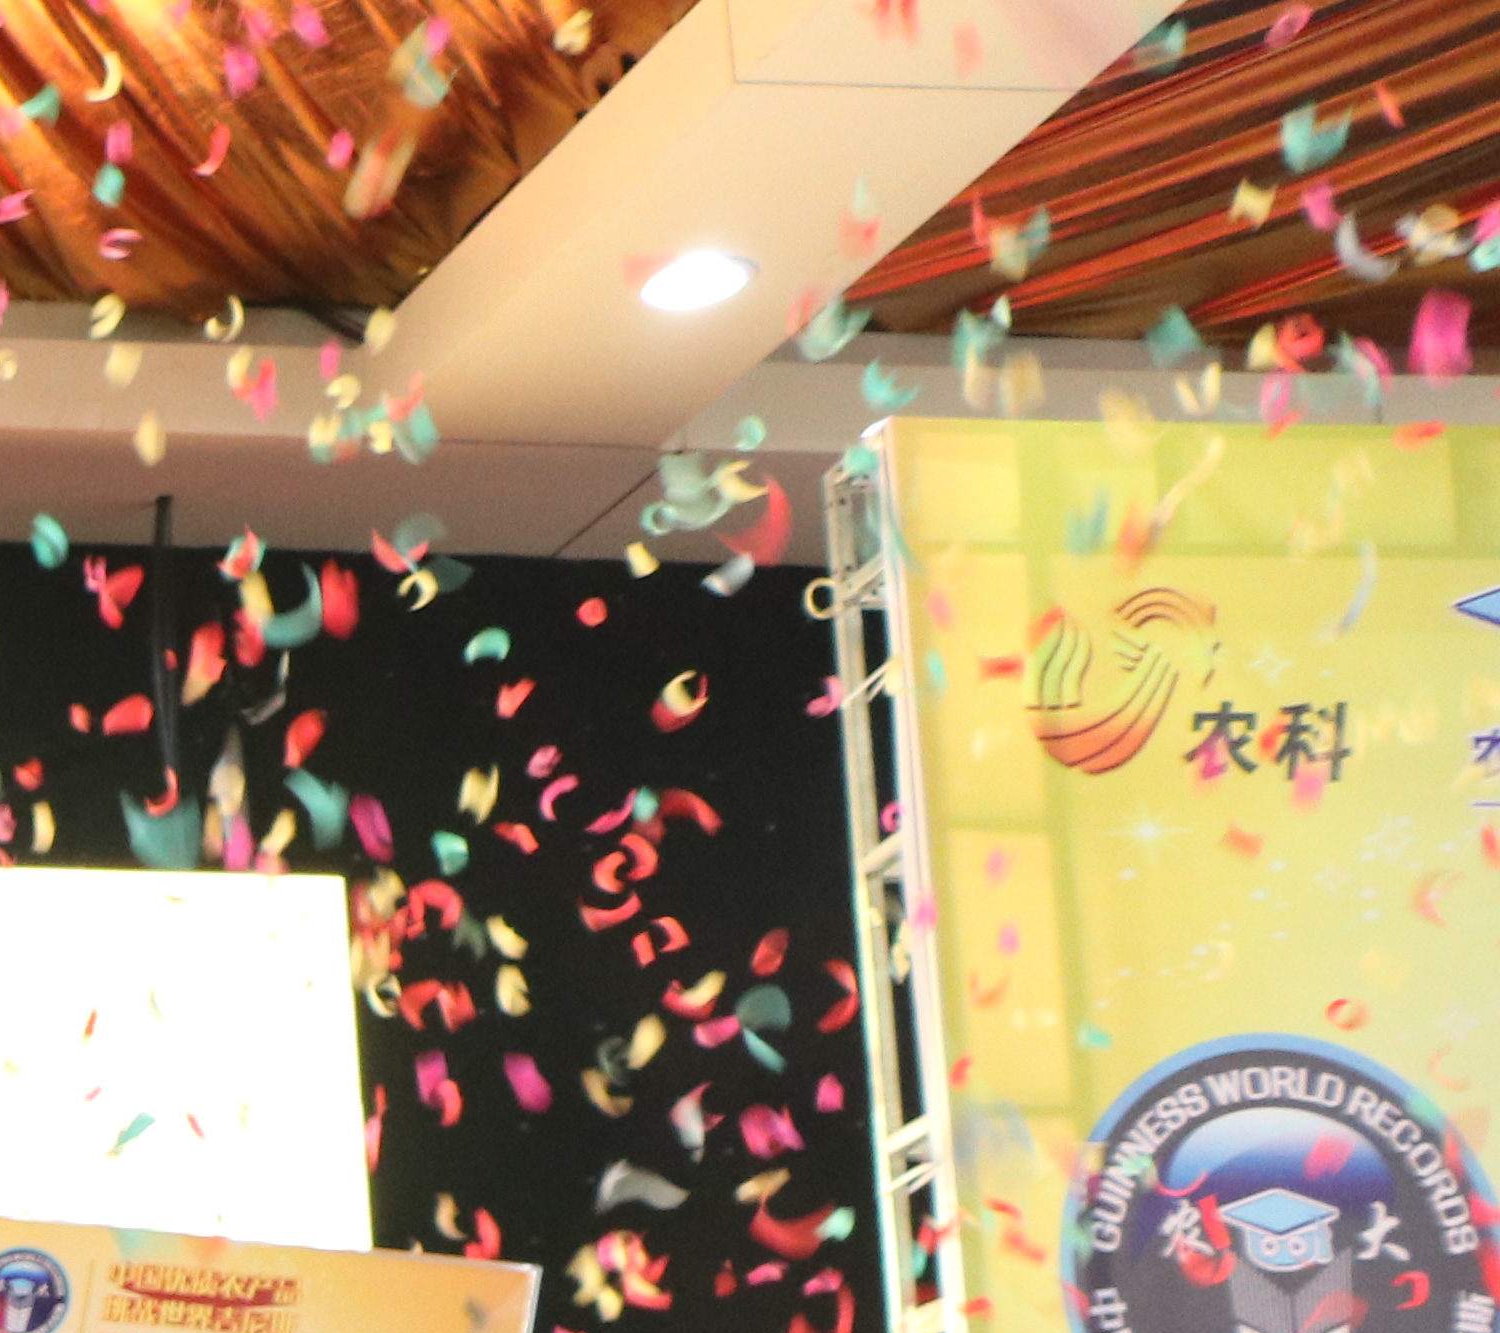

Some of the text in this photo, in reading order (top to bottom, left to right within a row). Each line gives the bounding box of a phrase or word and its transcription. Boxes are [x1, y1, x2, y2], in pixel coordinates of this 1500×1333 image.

[1184, 700, 1353, 782] 农科
[1204, 1065, 1345, 1110] WORLD
[1343, 1086, 1482, 1257] RECORDS
